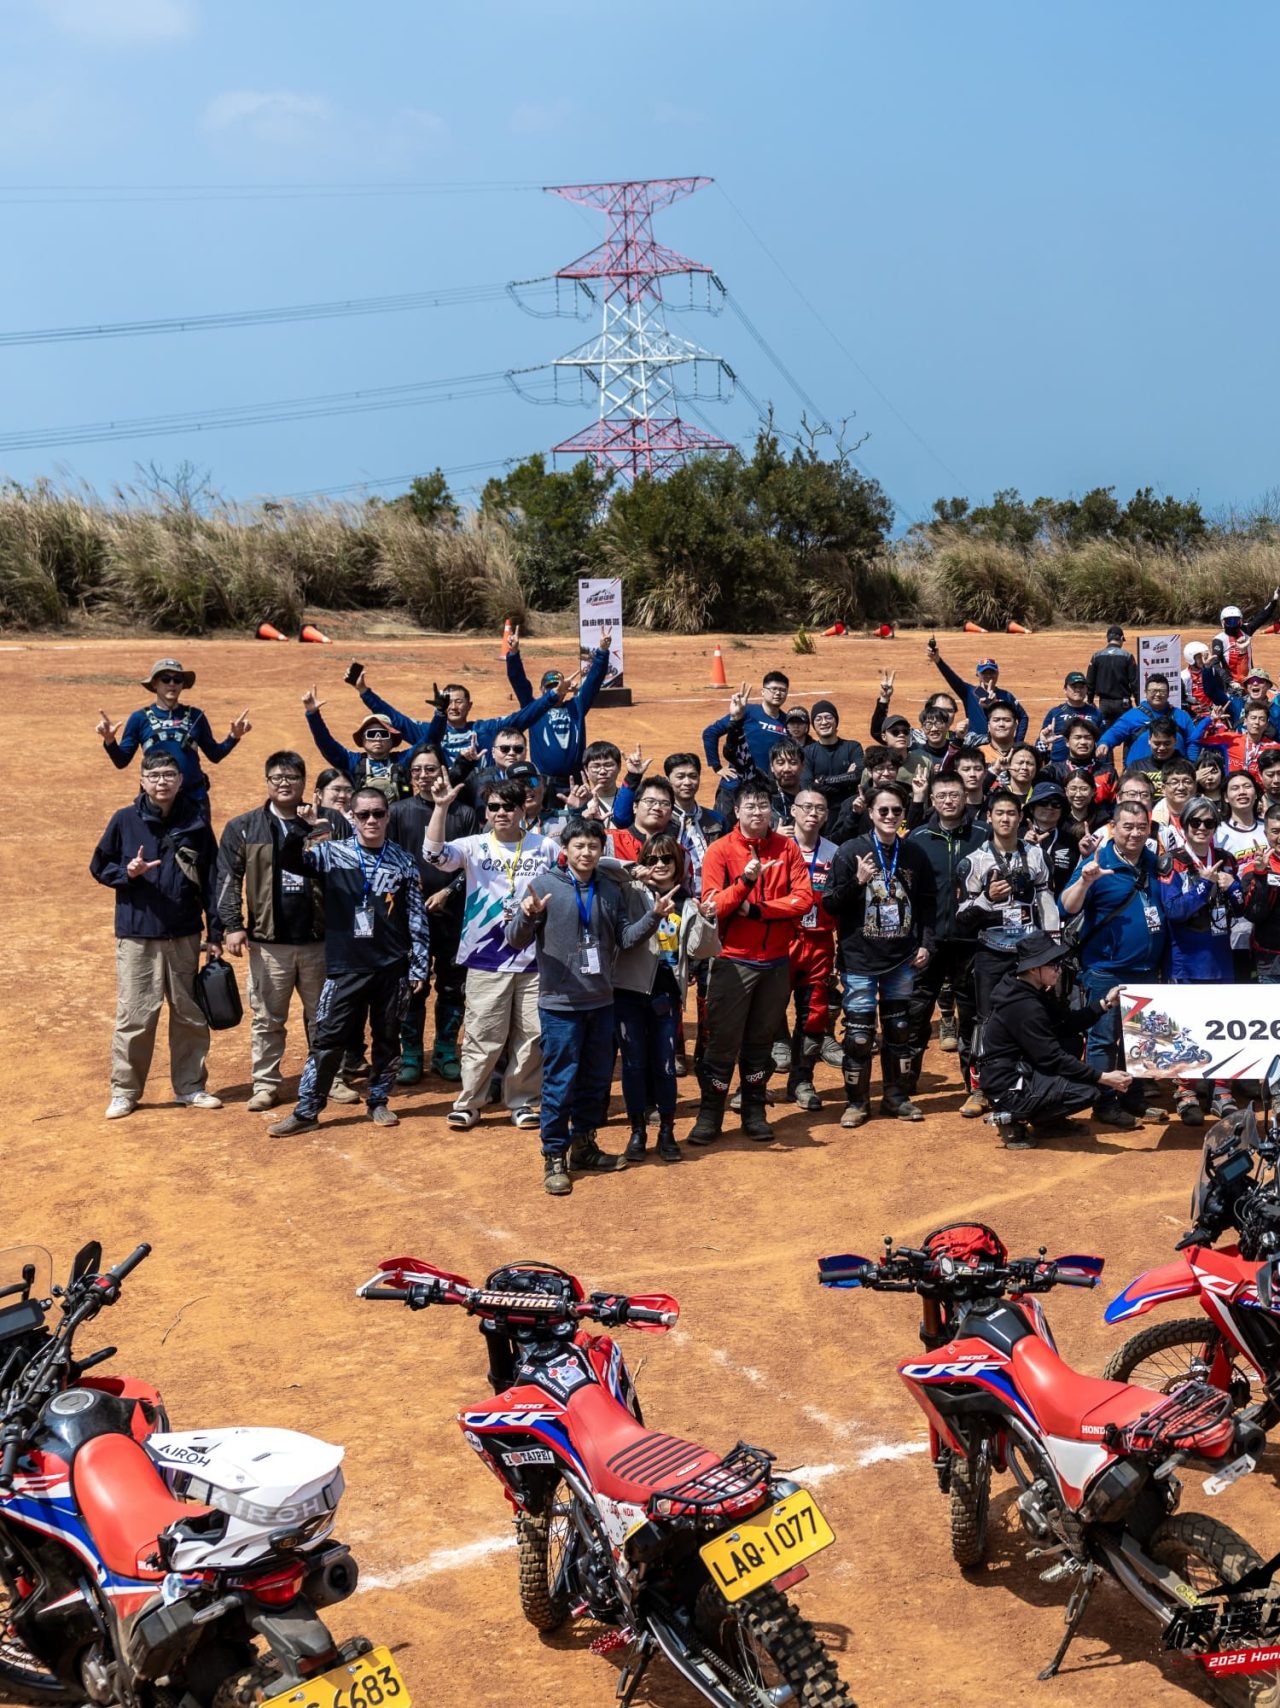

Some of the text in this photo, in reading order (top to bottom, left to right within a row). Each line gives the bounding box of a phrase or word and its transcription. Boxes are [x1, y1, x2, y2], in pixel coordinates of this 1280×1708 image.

[479, 1295, 558, 1308] RENTHAL
[902, 1361, 1009, 1378] CRF
[465, 1411, 566, 1427] CRF
[1081, 1425, 1106, 1435] HOND
[157, 1444, 211, 1467] AIROH
[209, 1490, 320, 1524] AIROH
[712, 1506, 817, 1587] LAQ-1077
[306, 1666, 400, 1708] 6683
